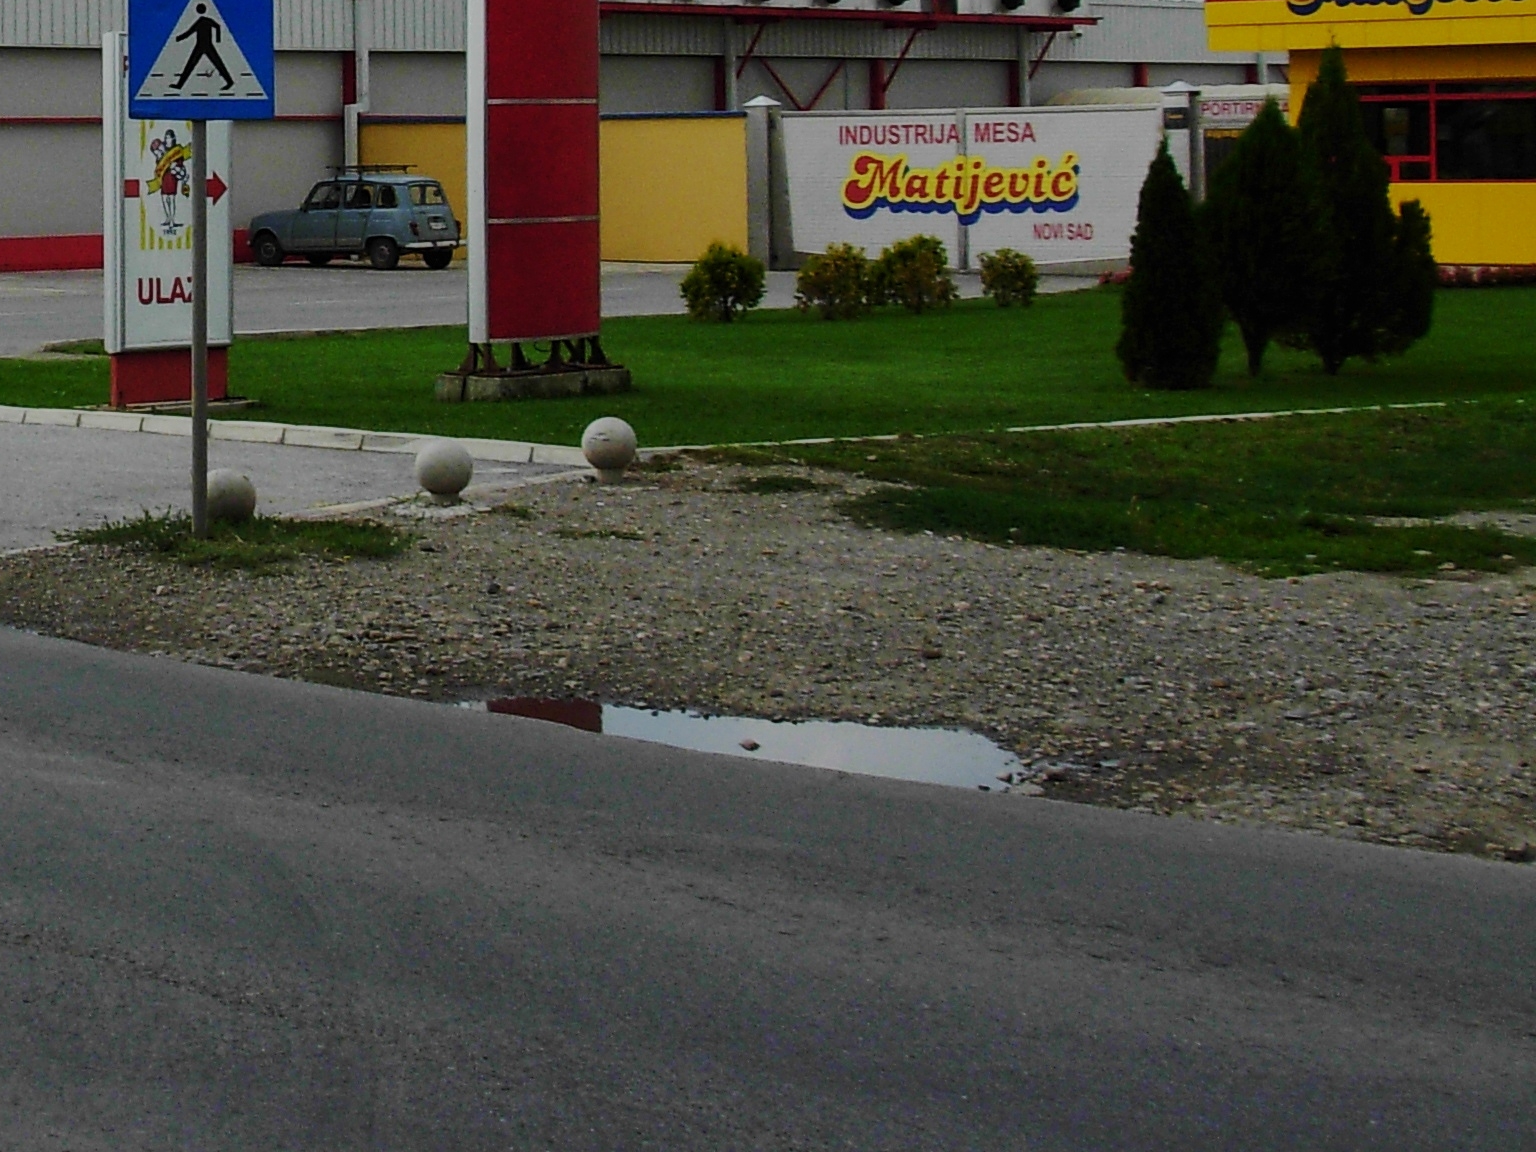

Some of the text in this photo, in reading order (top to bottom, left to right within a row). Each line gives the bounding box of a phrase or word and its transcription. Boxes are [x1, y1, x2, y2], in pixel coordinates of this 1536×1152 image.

[838, 121, 1037, 146] INDUSTRIJA MESA
[841, 151, 1079, 216] Matijević
[1032, 222, 1094, 241] NOVI SAD
[137, 275, 192, 305] ULA
